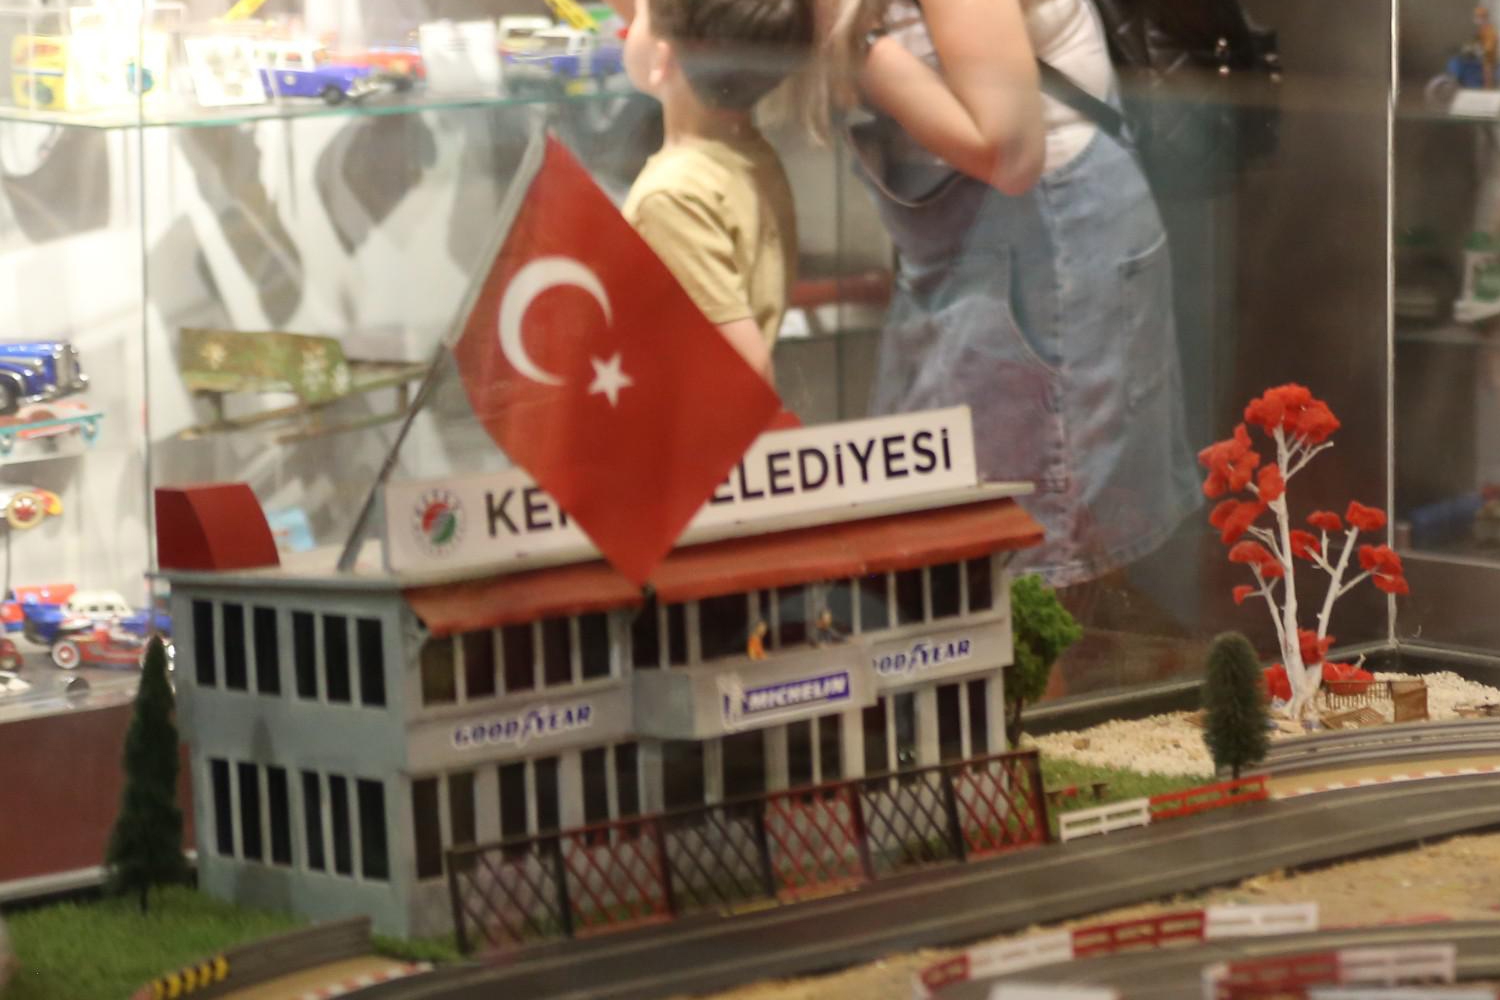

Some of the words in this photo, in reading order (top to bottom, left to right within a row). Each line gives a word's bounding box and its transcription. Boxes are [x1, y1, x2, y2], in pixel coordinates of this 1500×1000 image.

[484, 487, 567, 538] KE
[709, 428, 952, 505] LEDİYESİ
[748, 675, 847, 710] MICHELIN
